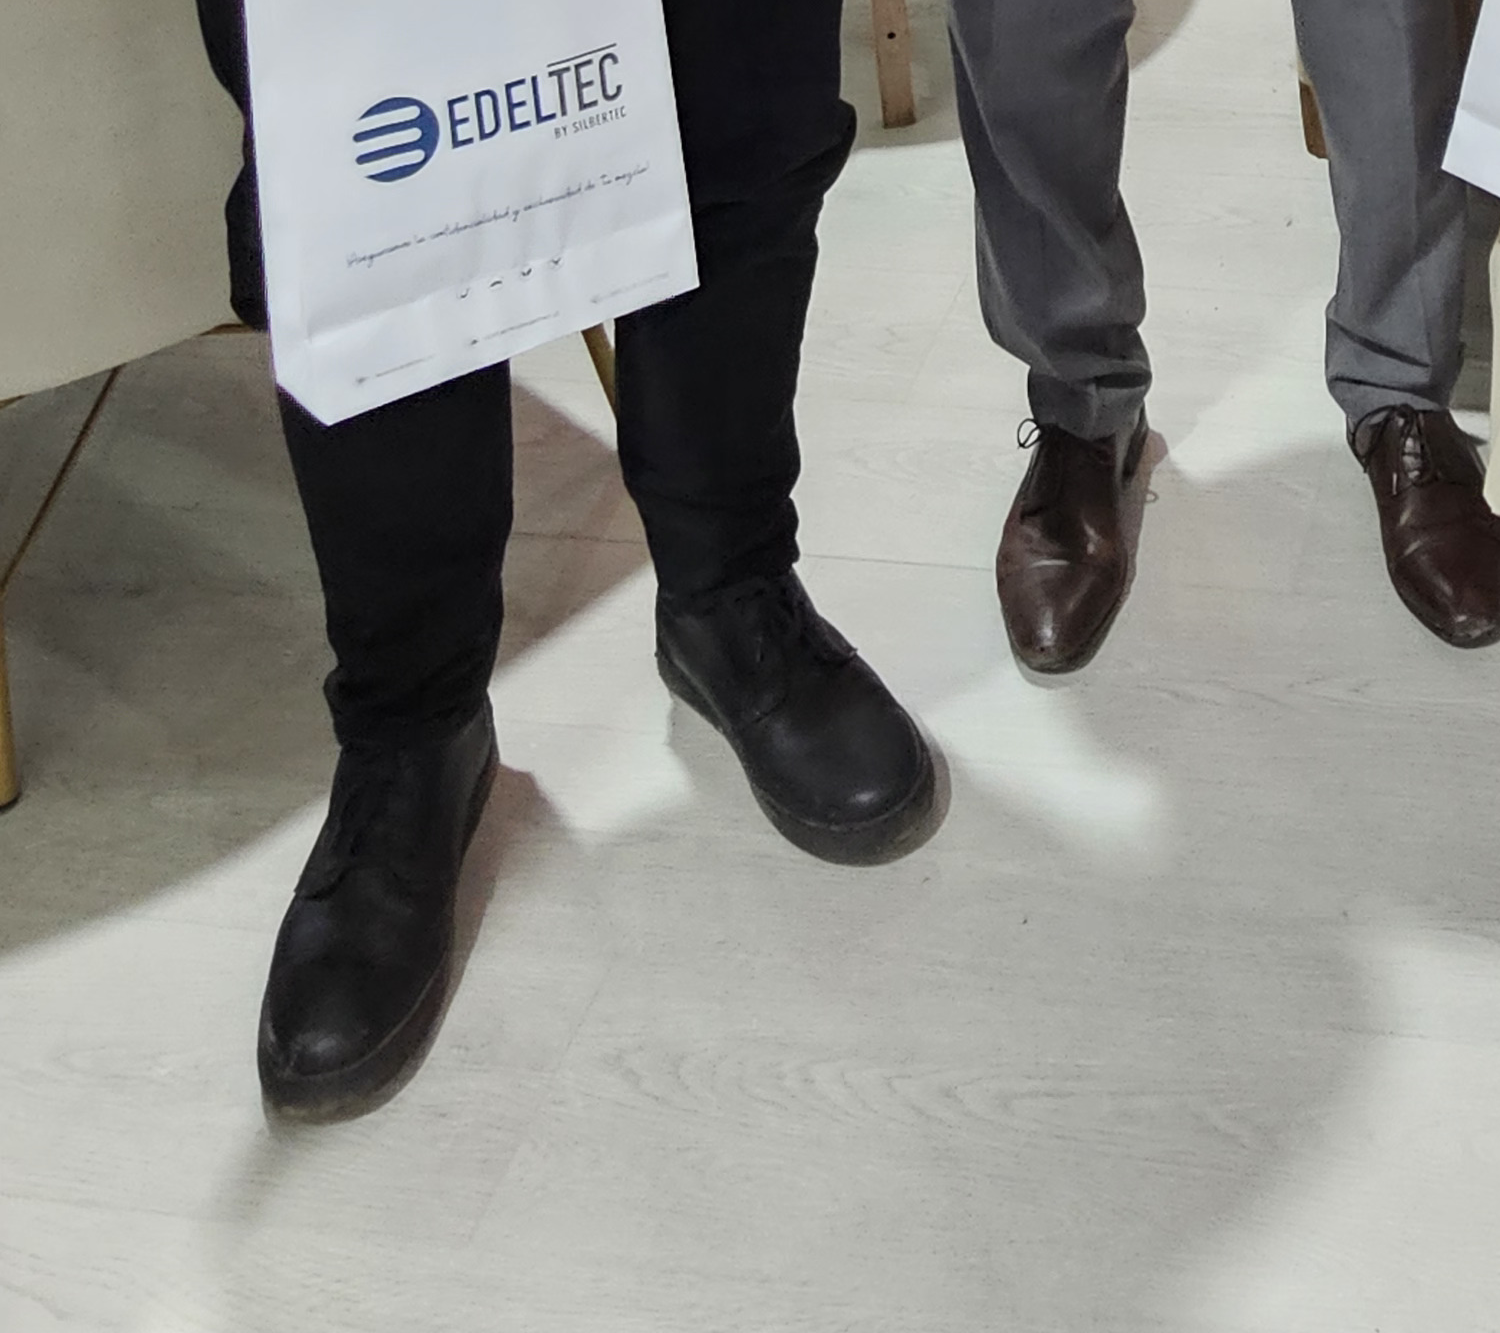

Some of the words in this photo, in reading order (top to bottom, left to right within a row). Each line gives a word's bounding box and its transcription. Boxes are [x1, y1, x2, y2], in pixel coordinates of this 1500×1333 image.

[446, 51, 623, 150] EDELTEC
[553, 125, 568, 140] BY
[572, 105, 627, 134] SILBERTEC
